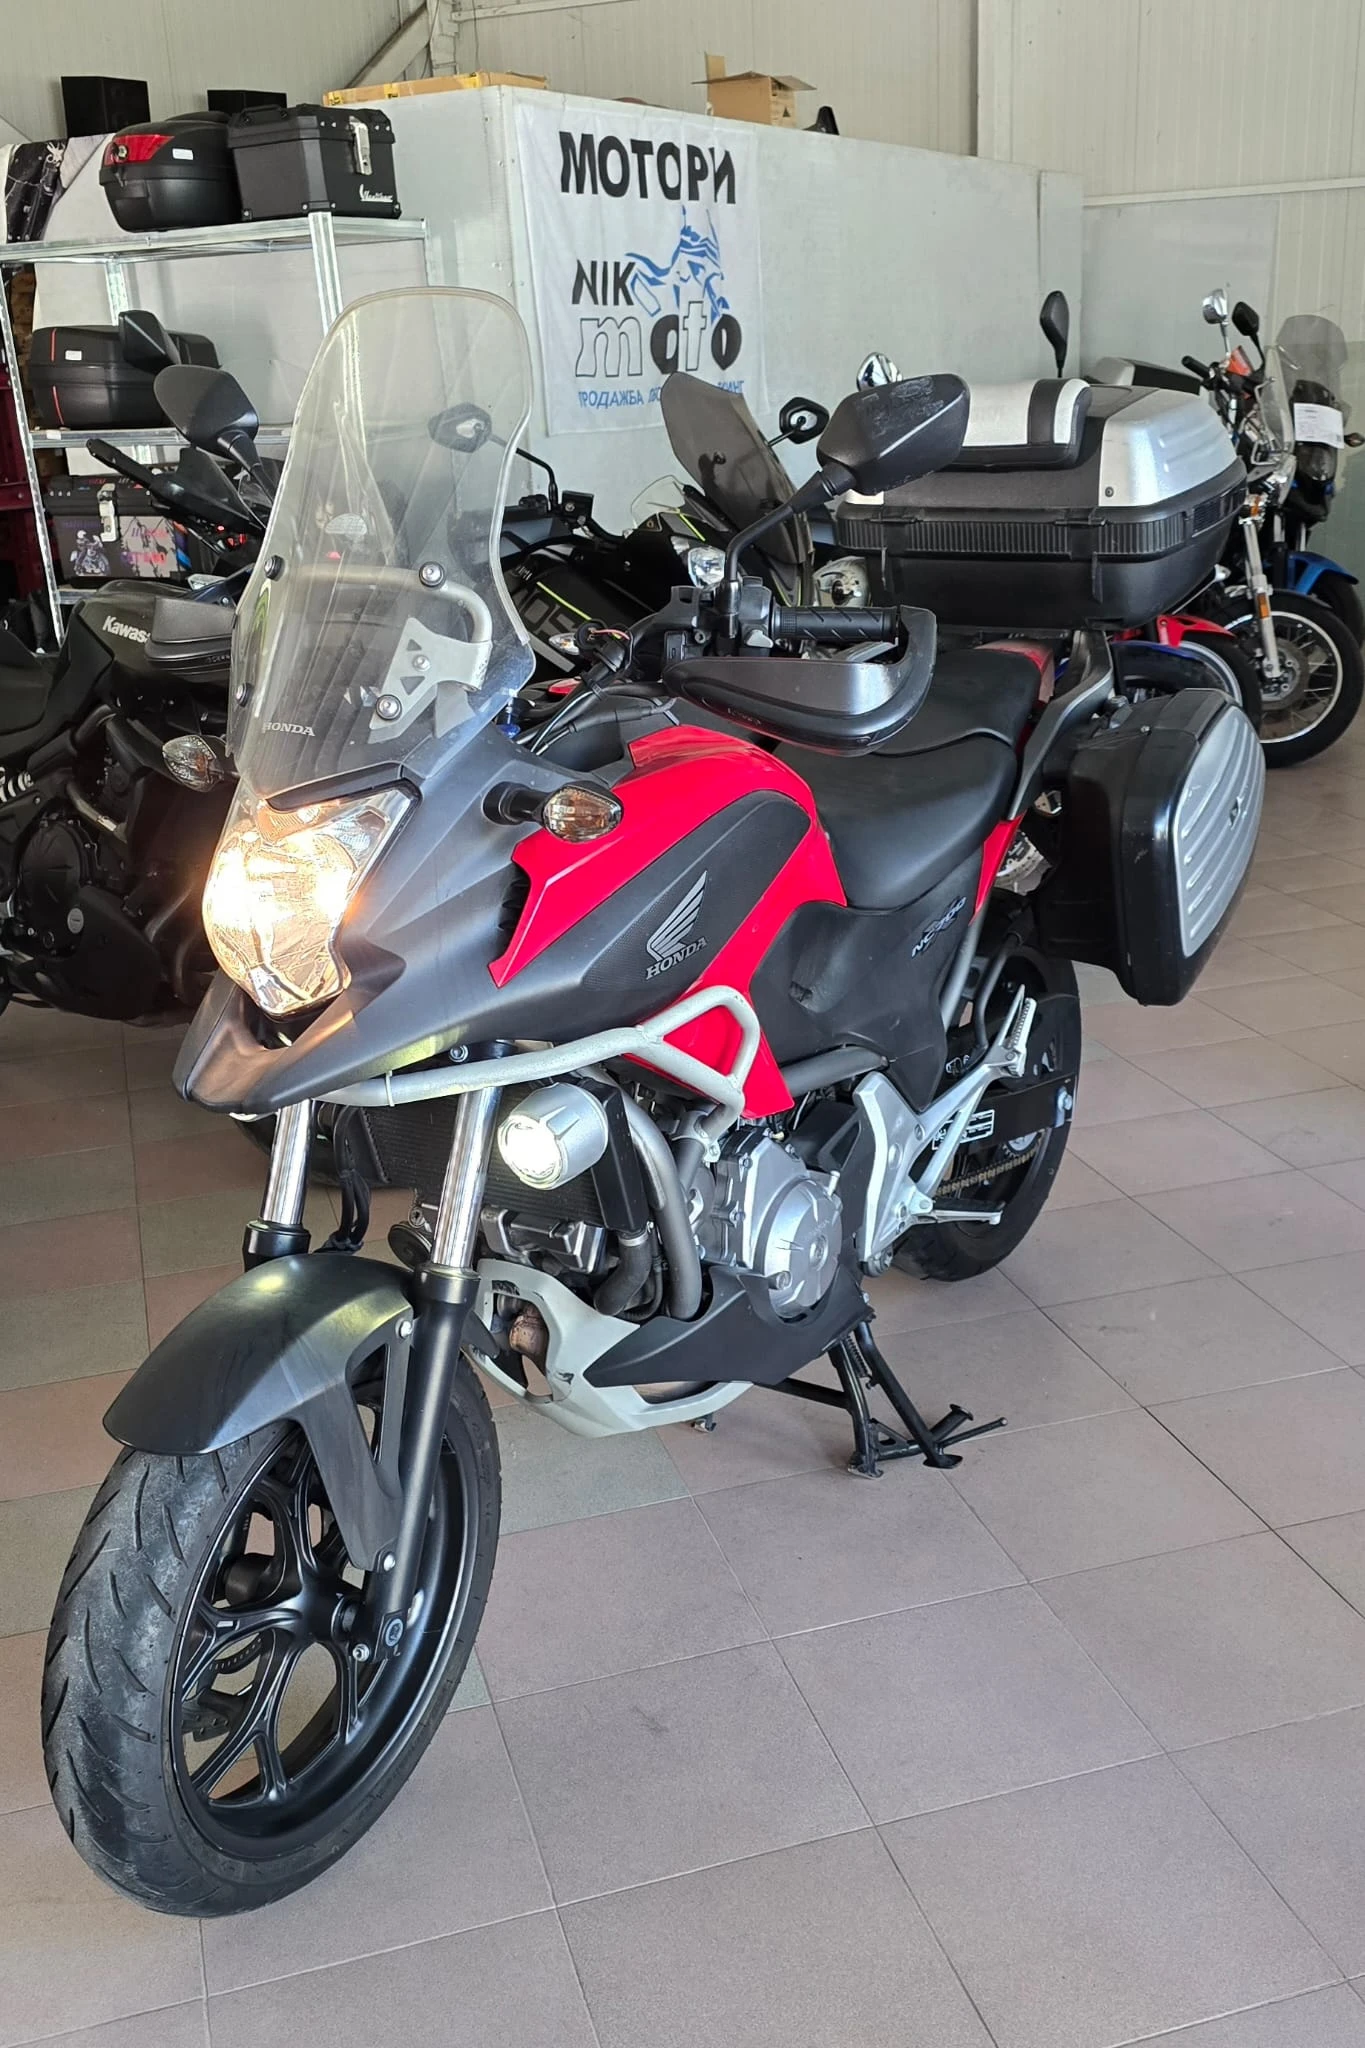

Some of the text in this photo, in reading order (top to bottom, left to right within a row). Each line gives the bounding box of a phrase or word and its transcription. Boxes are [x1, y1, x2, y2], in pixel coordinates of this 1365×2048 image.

[558, 131, 736, 204] МОТОРИ
[571, 259, 636, 306] NIK
[575, 300, 742, 378] moto
[261, 721, 316, 737] HONDA
[645, 937, 708, 980] HONDA
